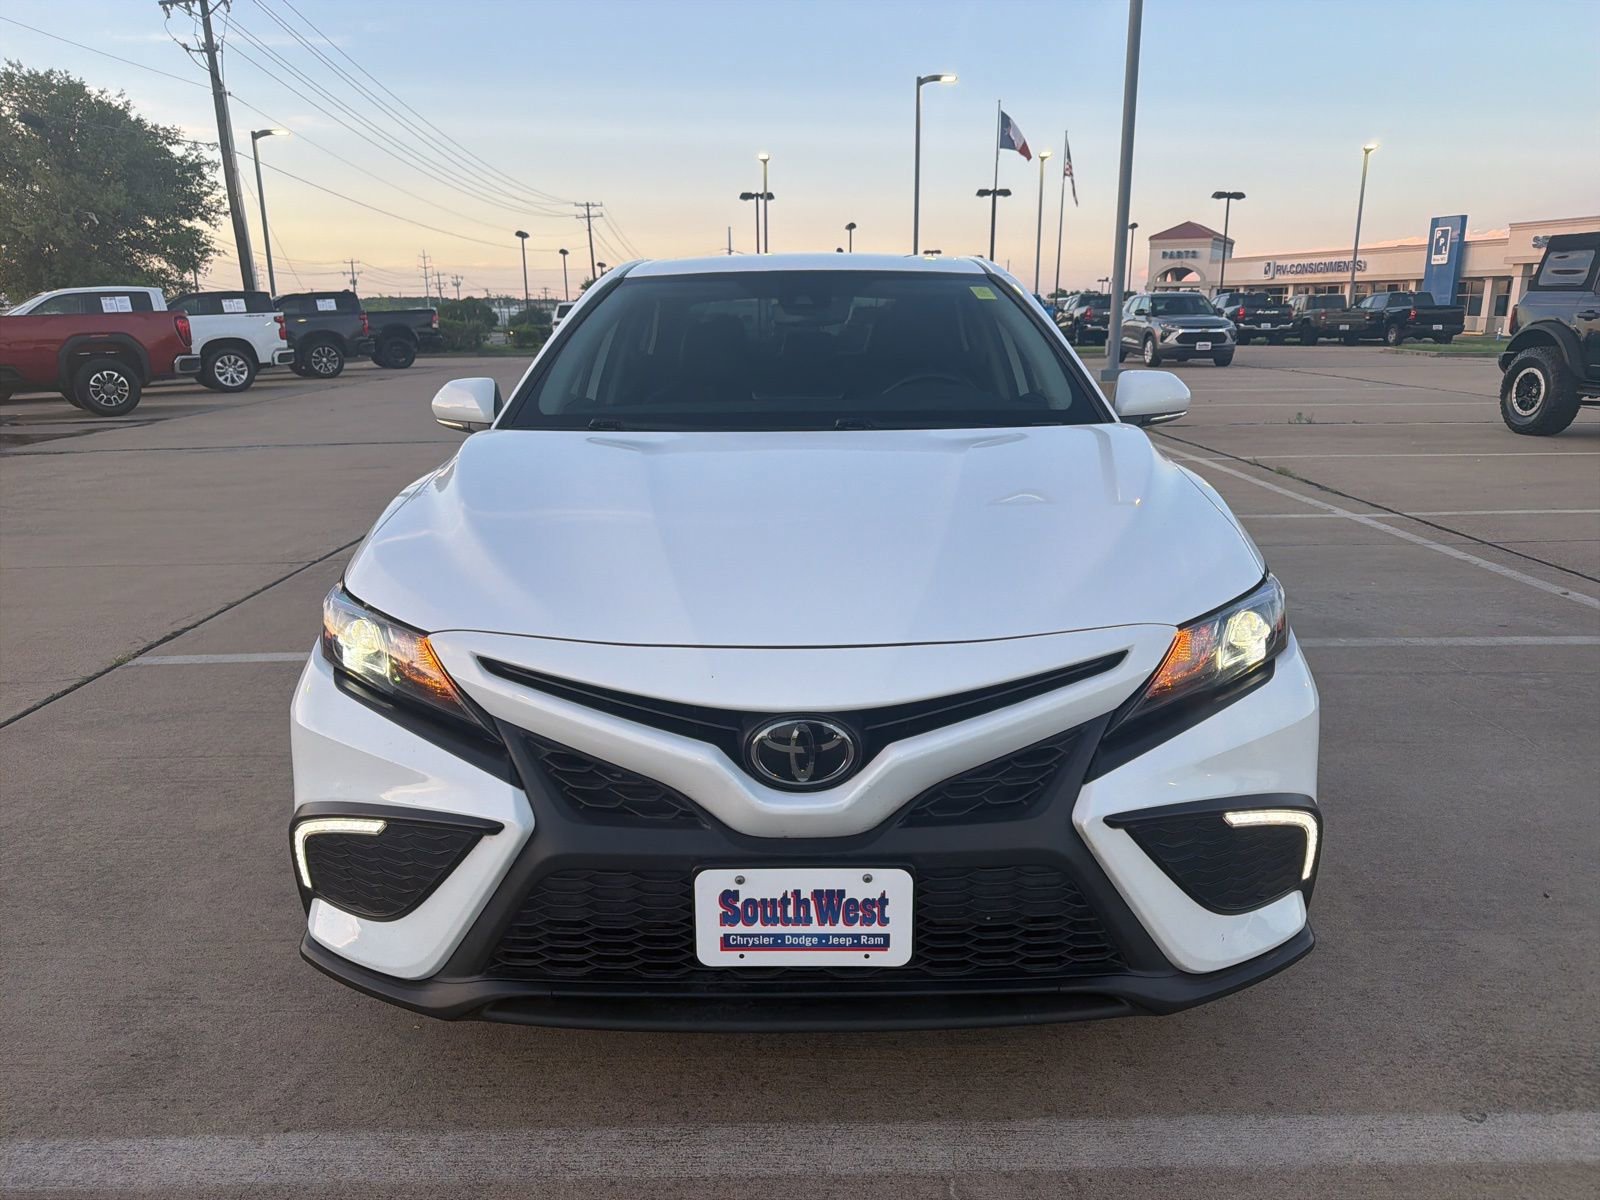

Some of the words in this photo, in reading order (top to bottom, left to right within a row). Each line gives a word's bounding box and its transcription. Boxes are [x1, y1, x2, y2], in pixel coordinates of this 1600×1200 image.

[1161, 250, 1198, 259] PARTS
[719, 889, 890, 927] SouthWest
[729, 935, 775, 946] Chrysler
[785, 935, 818, 946] Dodge
[828, 936, 853, 946] Jeep
[860, 935, 884, 945] Ram
